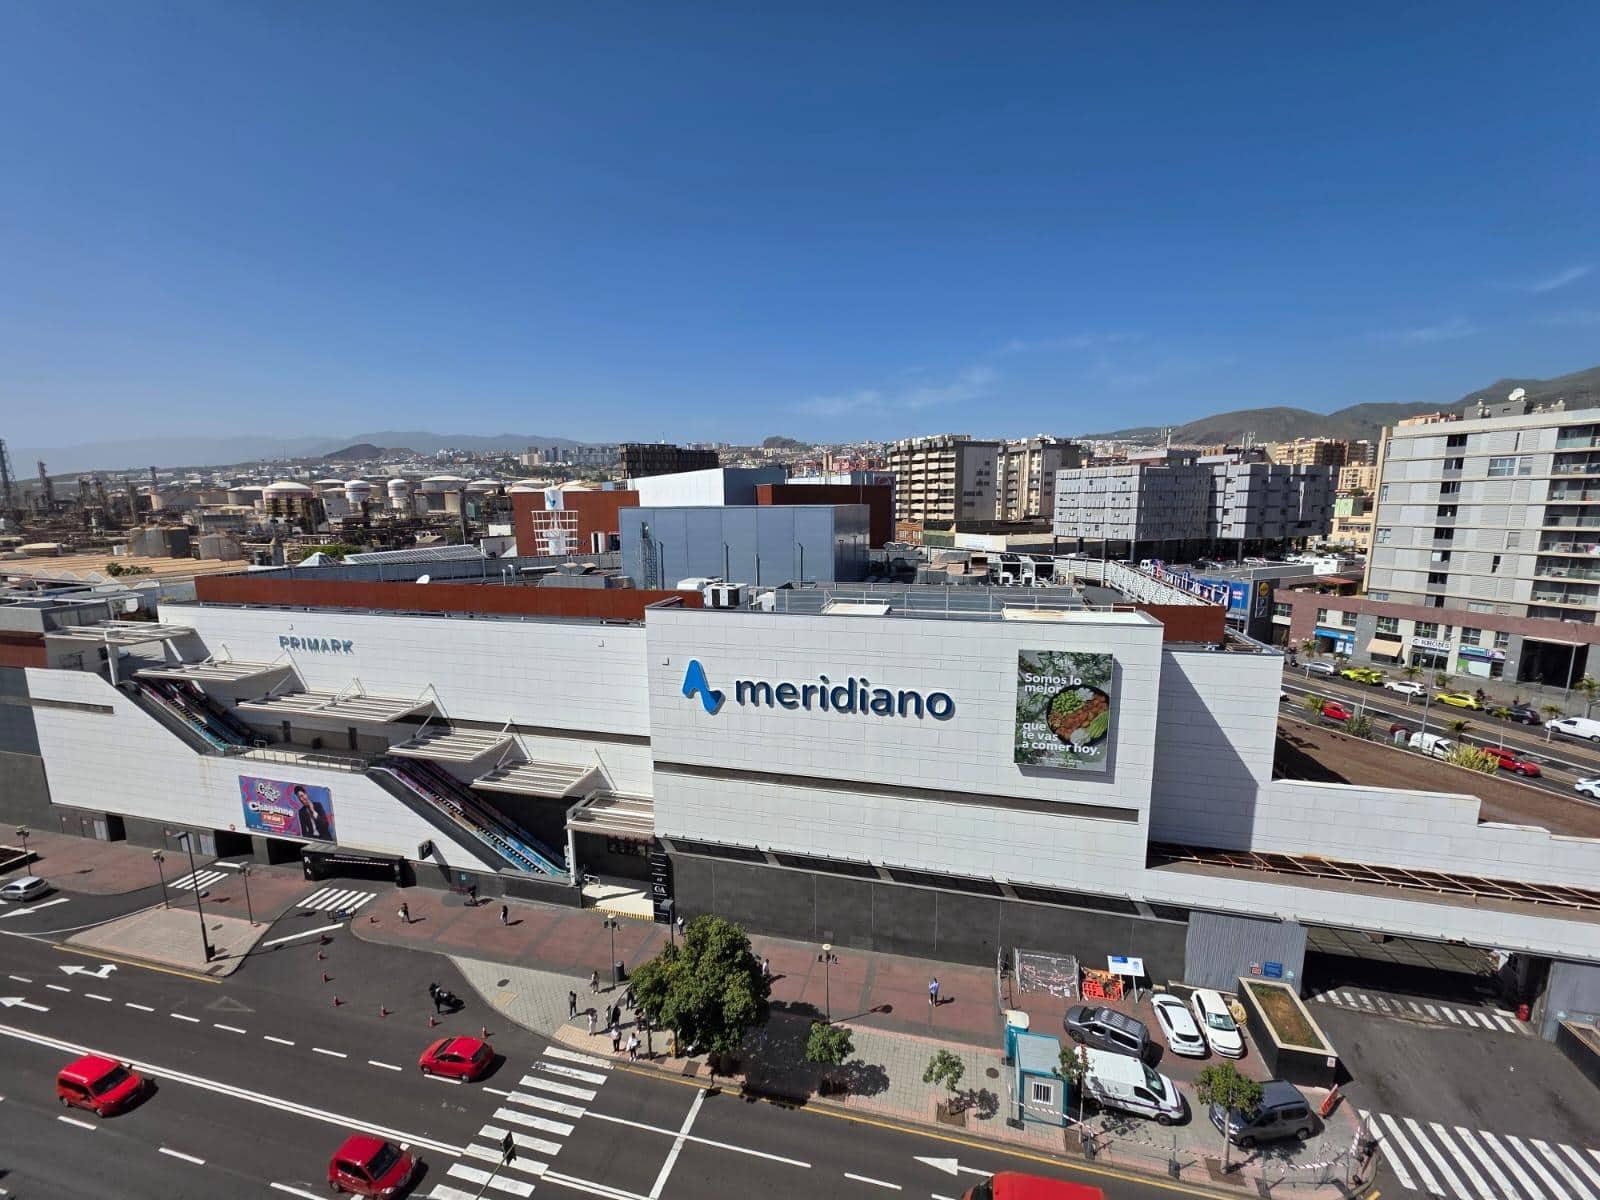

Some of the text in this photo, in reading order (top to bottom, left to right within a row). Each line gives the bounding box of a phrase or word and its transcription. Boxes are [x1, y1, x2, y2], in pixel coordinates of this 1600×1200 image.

[279, 635, 353, 653] PRIMARK
[1025, 673, 1082, 685] Somos lo
[1024, 682, 1062, 695] mejor
[735, 675, 955, 721] meridiano
[1022, 722, 1046, 732] que
[1022, 731, 1058, 741] te vas
[1031, 742, 1074, 752] comer
[1074, 743, 1100, 756] hoy.
